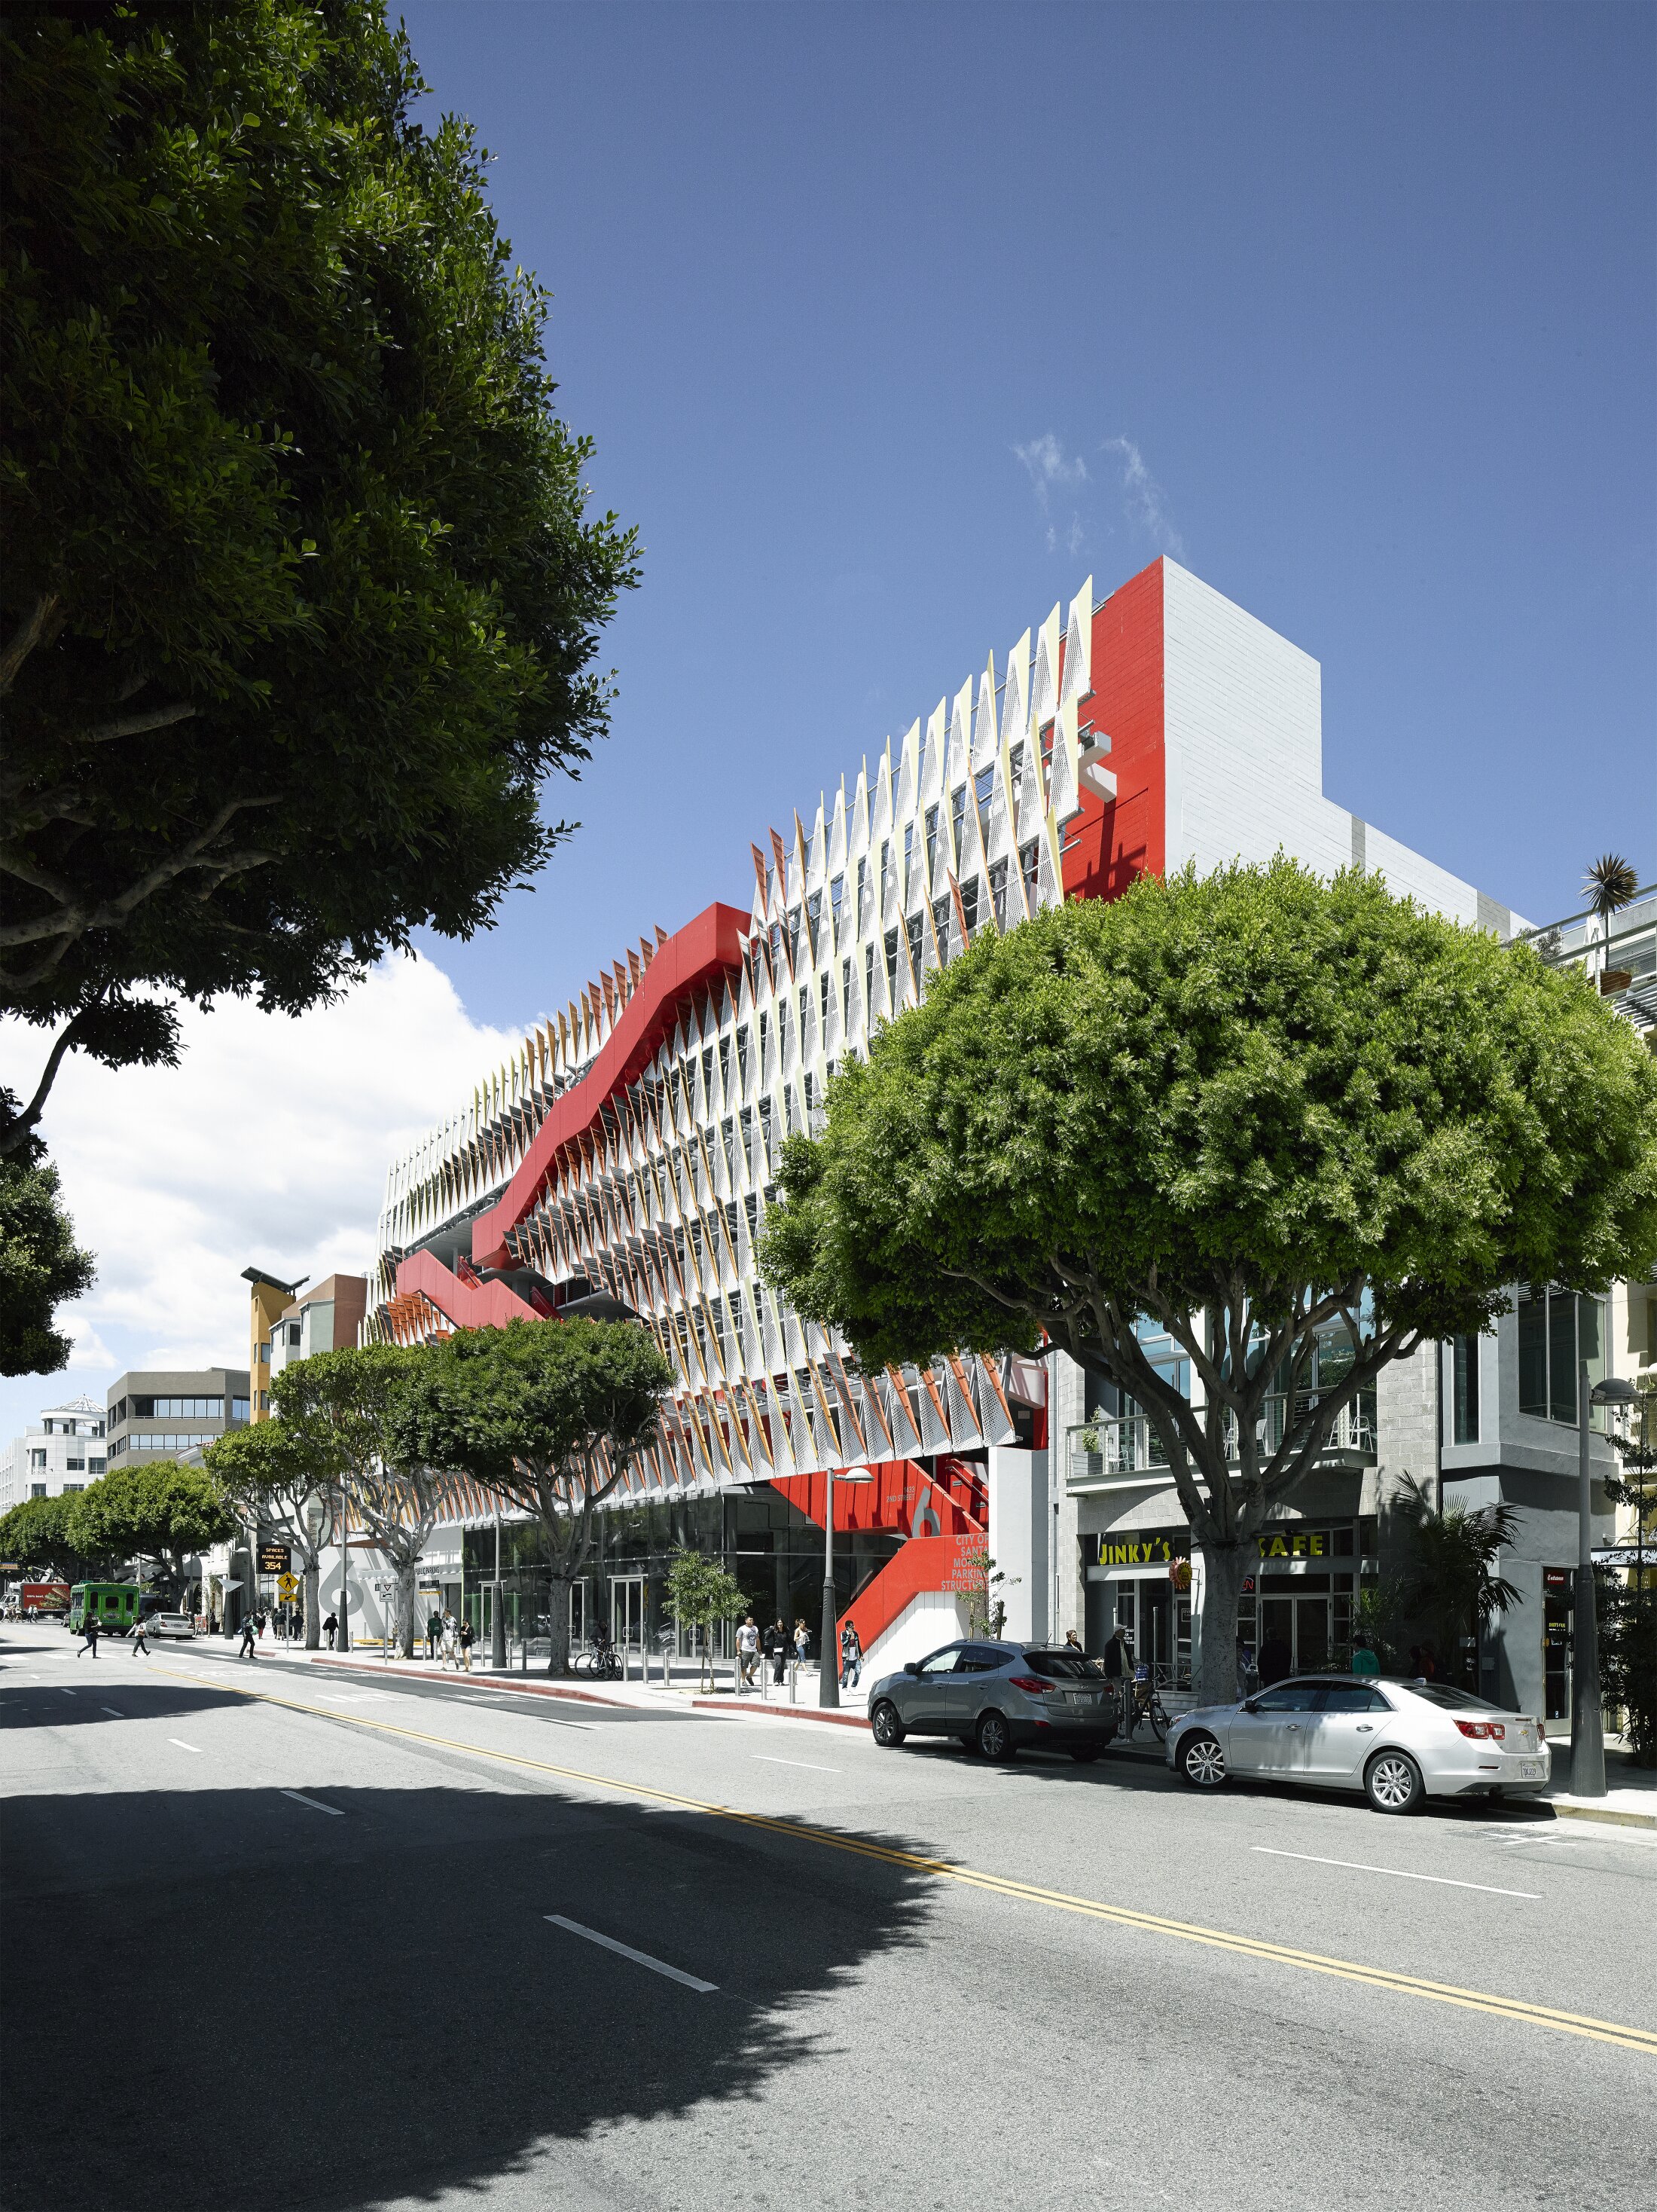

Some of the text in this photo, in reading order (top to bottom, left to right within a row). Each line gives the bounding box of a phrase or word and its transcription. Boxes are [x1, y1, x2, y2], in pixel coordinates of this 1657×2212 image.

[911, 1485, 940, 1538] 6
[956, 1533, 989, 1545] CITY OF
[1100, 1538, 1170, 1565] JINKY'S
[264, 1562, 282, 1570] 354
[426, 1566, 439, 1575] PARKING
[319, 1560, 365, 1617] 6
